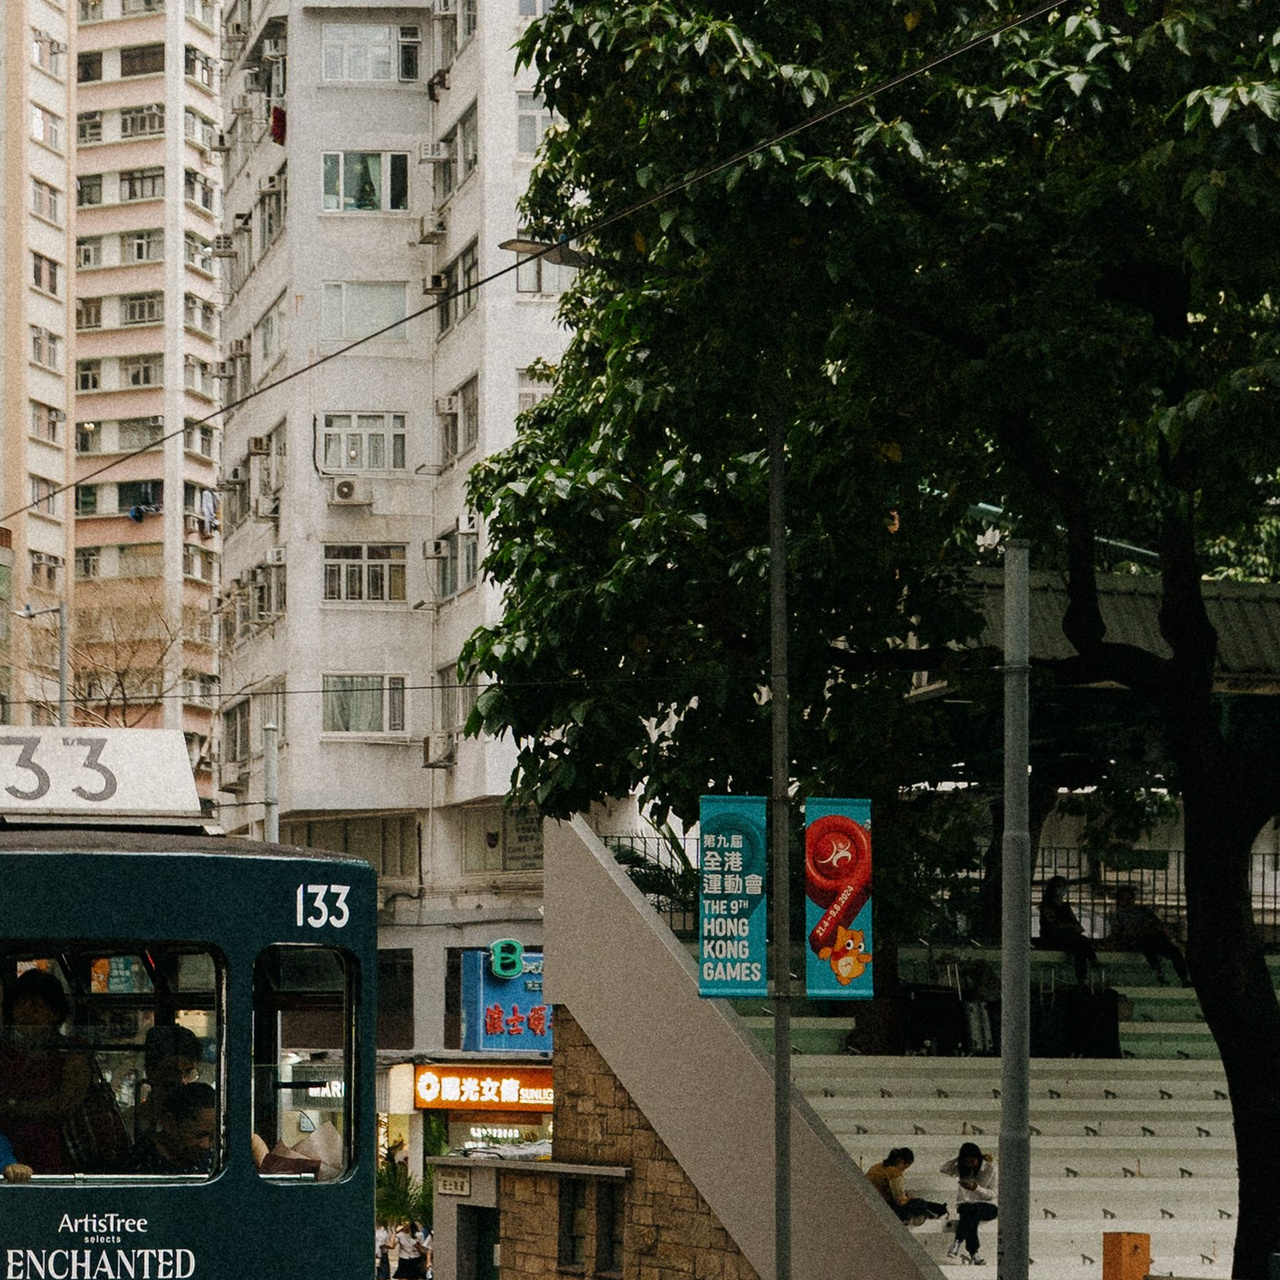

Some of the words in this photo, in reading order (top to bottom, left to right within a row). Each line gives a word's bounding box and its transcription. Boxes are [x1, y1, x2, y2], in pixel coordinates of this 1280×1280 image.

[703, 834, 744, 849] 第九屆
[703, 851, 743, 872] 全港
[703, 874, 763, 895] 運動會
[296, 884, 351, 928] 133
[703, 900, 728, 915] THE
[703, 918, 750, 937] HONG
[703, 939, 750, 959] KONG
[703, 962, 762, 982] GAMES
[58, 1213, 148, 1233] ArtisTree
[84, 1235, 122, 1244] selects
[6, 1248, 196, 1280] ENCHANTED
